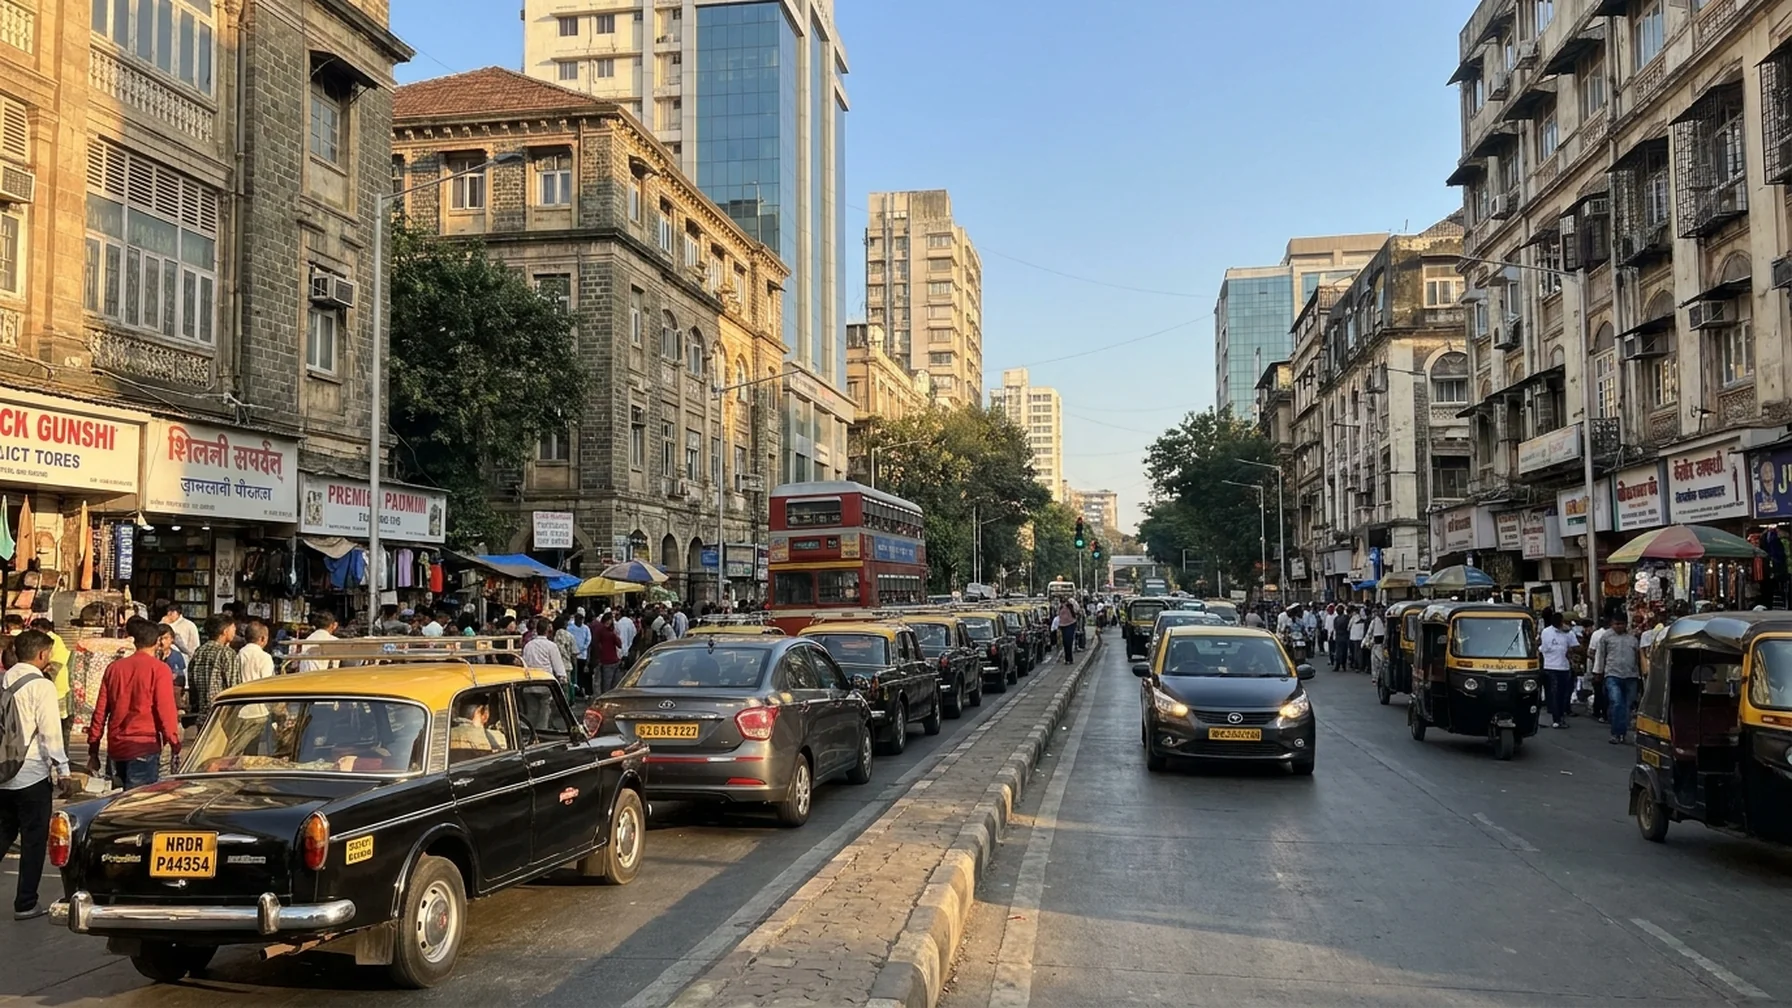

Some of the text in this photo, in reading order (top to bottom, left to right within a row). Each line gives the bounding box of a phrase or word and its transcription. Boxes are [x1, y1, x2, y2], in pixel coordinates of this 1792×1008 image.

[37, 414, 116, 450] GUNSHI
[35, 449, 81, 469] TORES
[166, 837, 203, 852] NRDR
